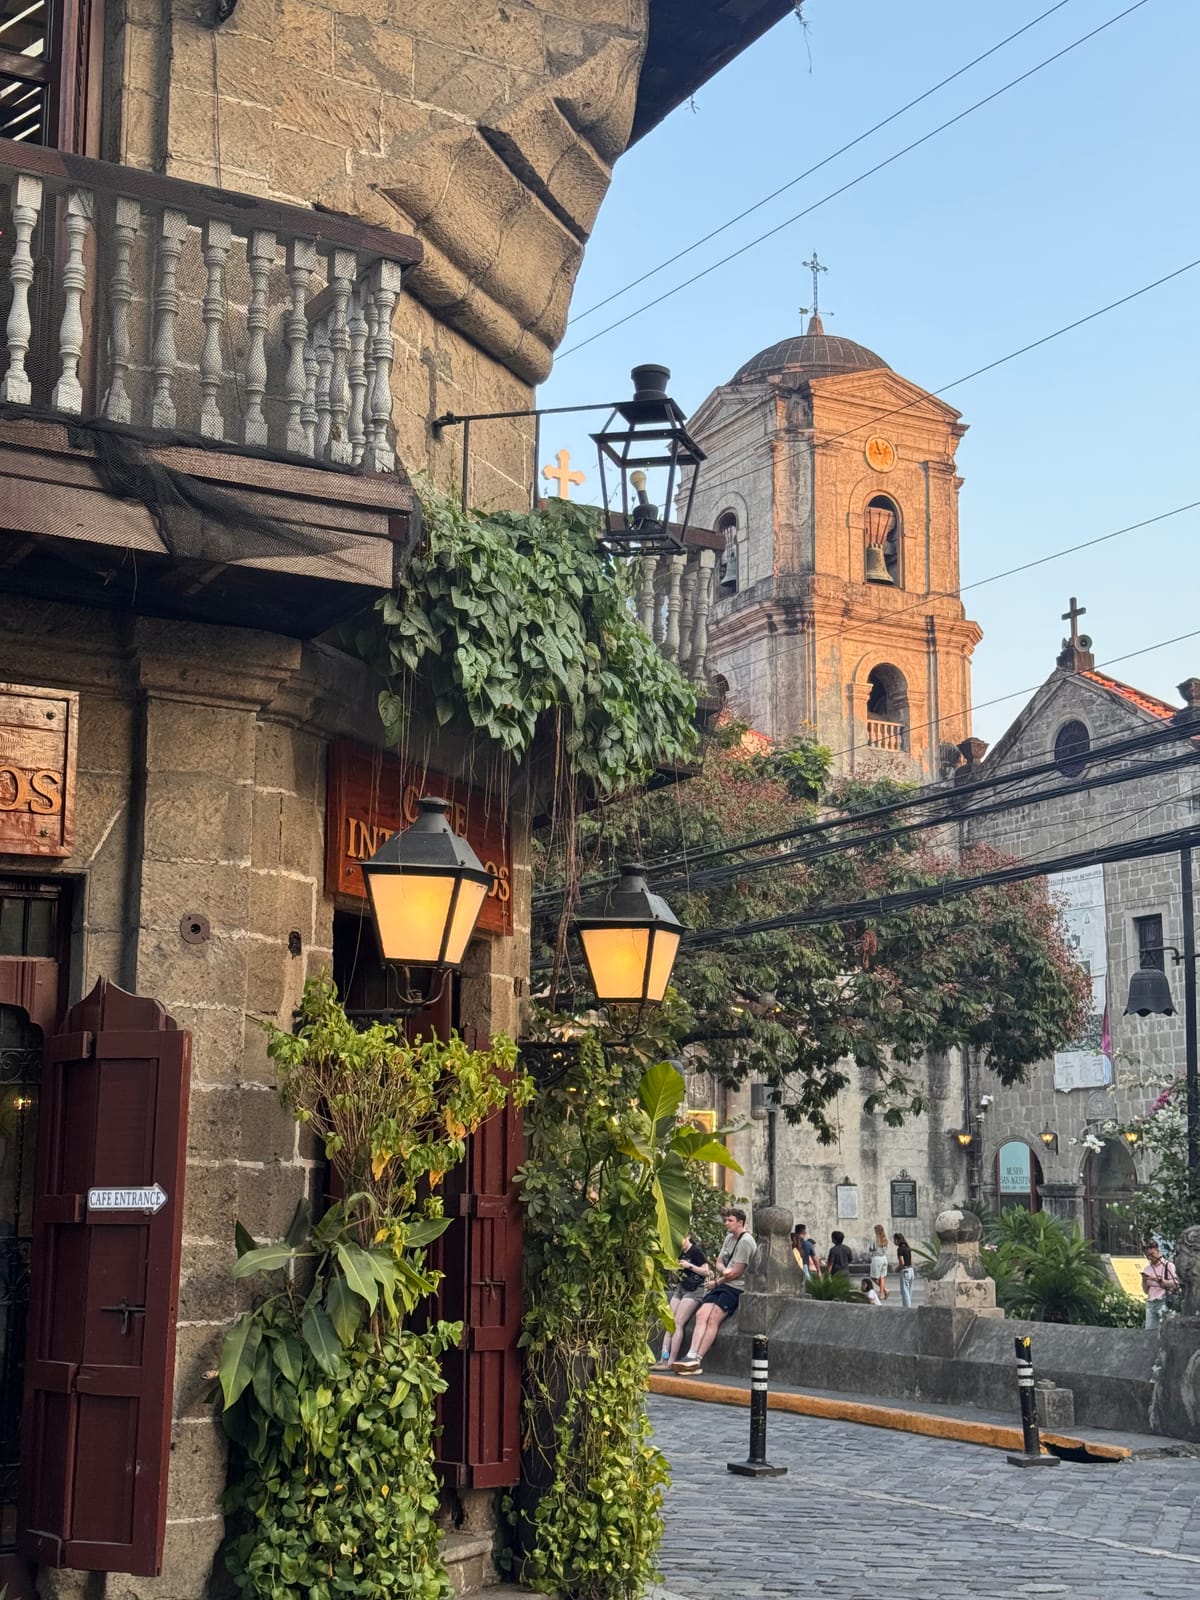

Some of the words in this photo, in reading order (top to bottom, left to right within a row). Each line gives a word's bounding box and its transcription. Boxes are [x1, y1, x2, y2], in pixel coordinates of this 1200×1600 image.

[403, 785, 468, 836] CE
[347, 817, 510, 902] INTOS
[90, 1192, 112, 1206] CAFE
[114, 1191, 161, 1206] ENTRANCE
